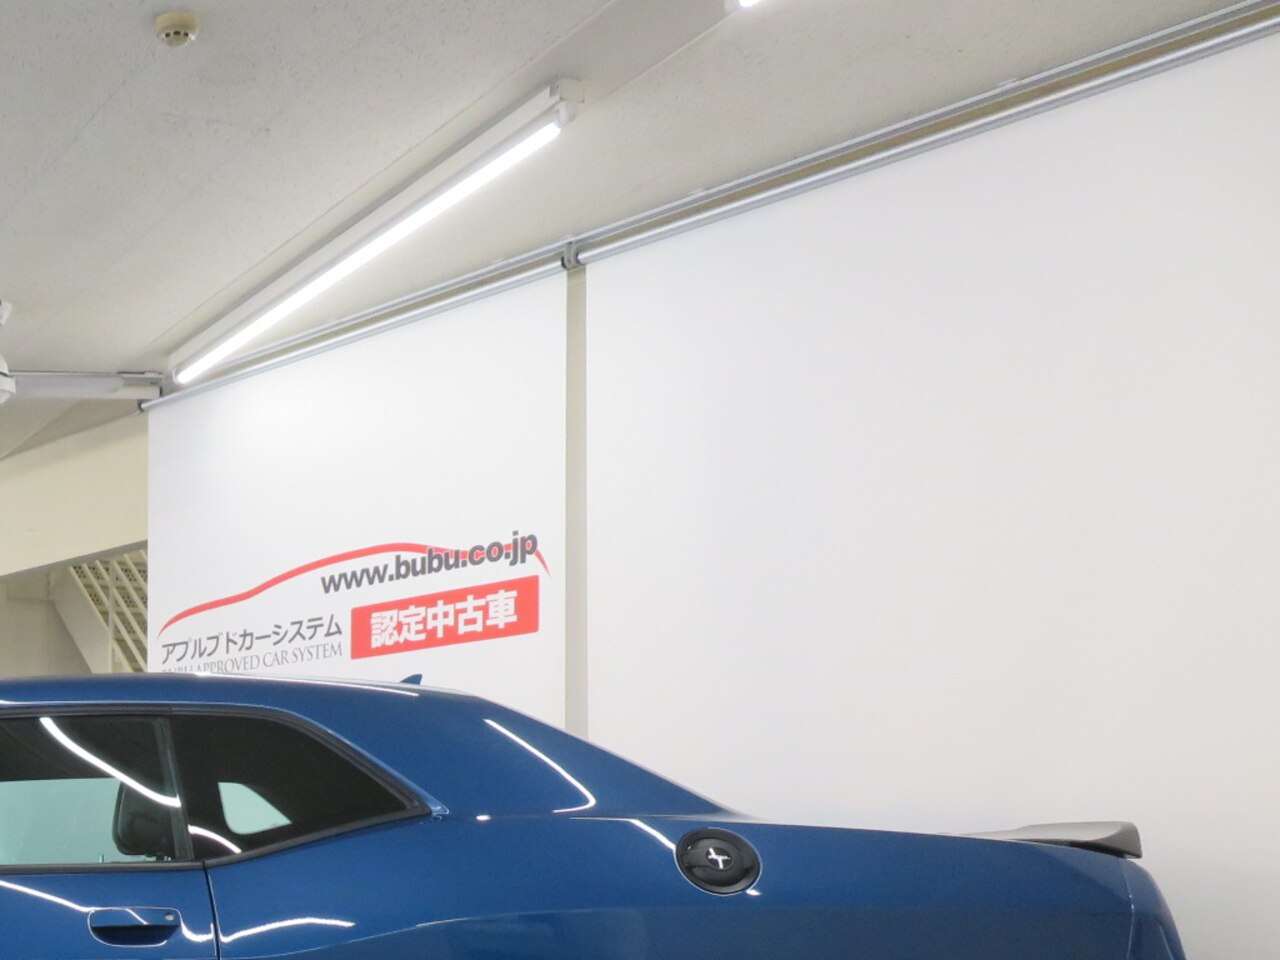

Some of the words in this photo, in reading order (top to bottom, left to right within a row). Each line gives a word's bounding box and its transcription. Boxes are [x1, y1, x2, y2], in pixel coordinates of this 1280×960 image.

[321, 530, 538, 594] www.bubu.co.jp
[162, 613, 342, 664] アプルブドカーシステム
[370, 589, 518, 648] 認定中古車
[195, 654, 261, 674] APPROVED
[262, 649, 291, 667] CAR
[291, 642, 343, 664] SYSTEM
